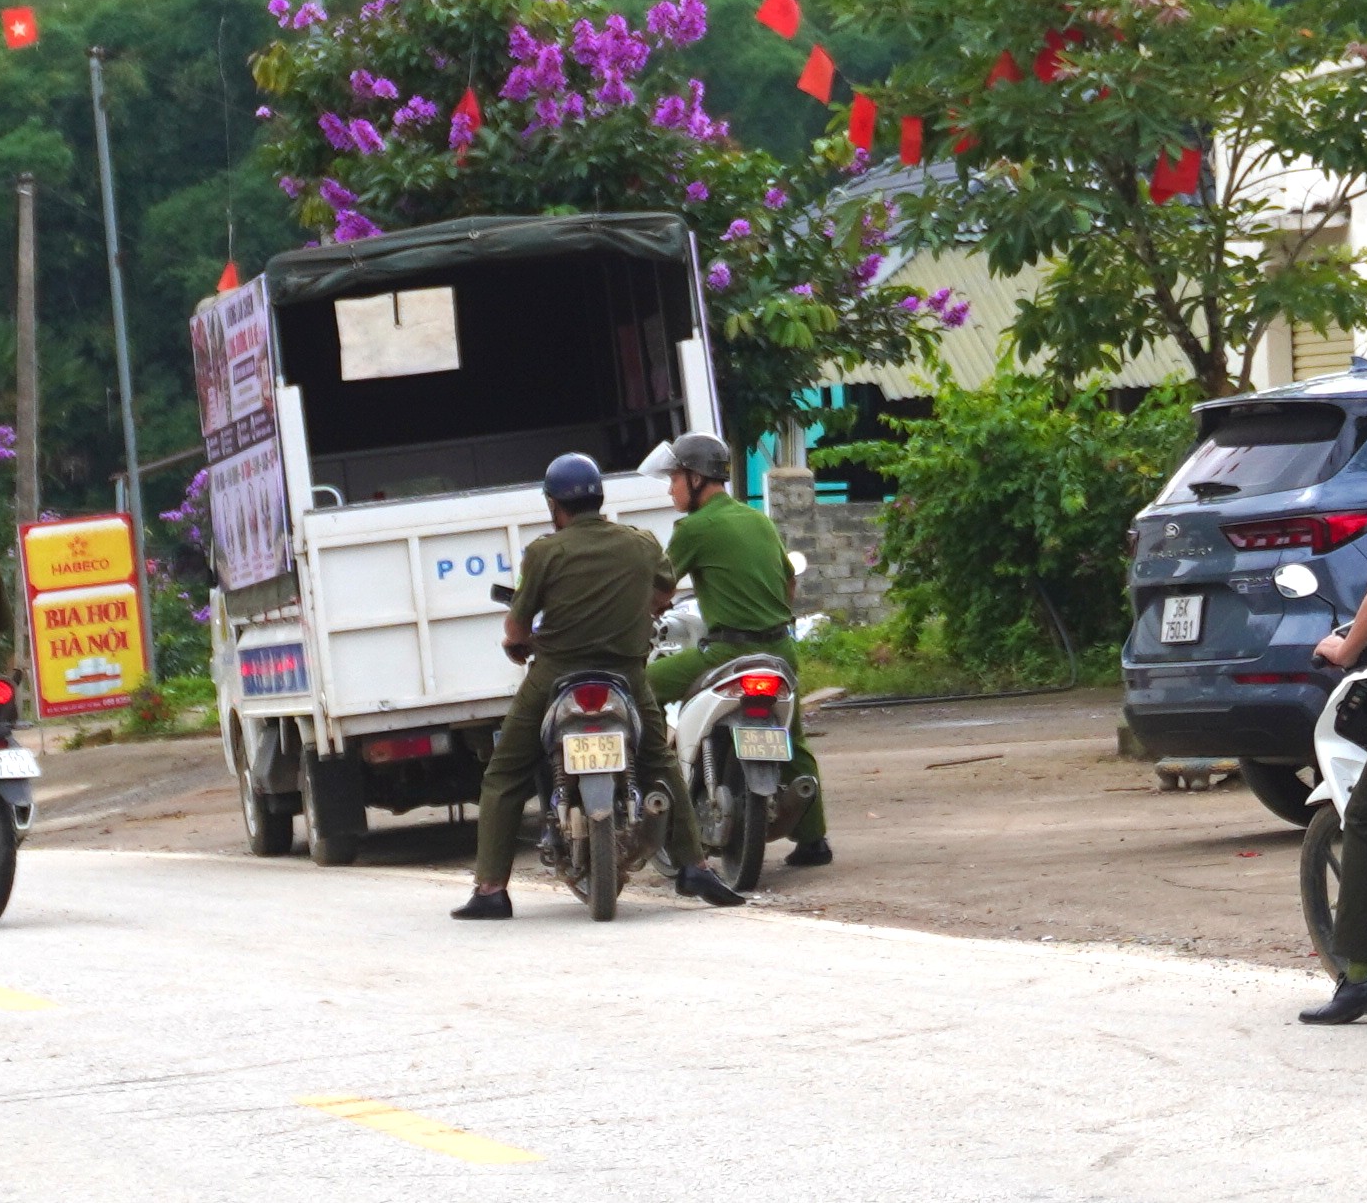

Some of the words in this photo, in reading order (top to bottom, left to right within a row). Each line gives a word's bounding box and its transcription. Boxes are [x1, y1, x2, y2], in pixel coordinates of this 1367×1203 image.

[52, 559, 110, 576] HABECO
[44, 605, 83, 630] BIA
[86, 600, 129, 625] HƠI
[1174, 598, 1191, 618] 36K
[1166, 620, 1194, 640] 750.91
[50, 632, 84, 659] HÀ
[86, 627, 129, 657] NỘI
[570, 753, 620, 770] 118.77
